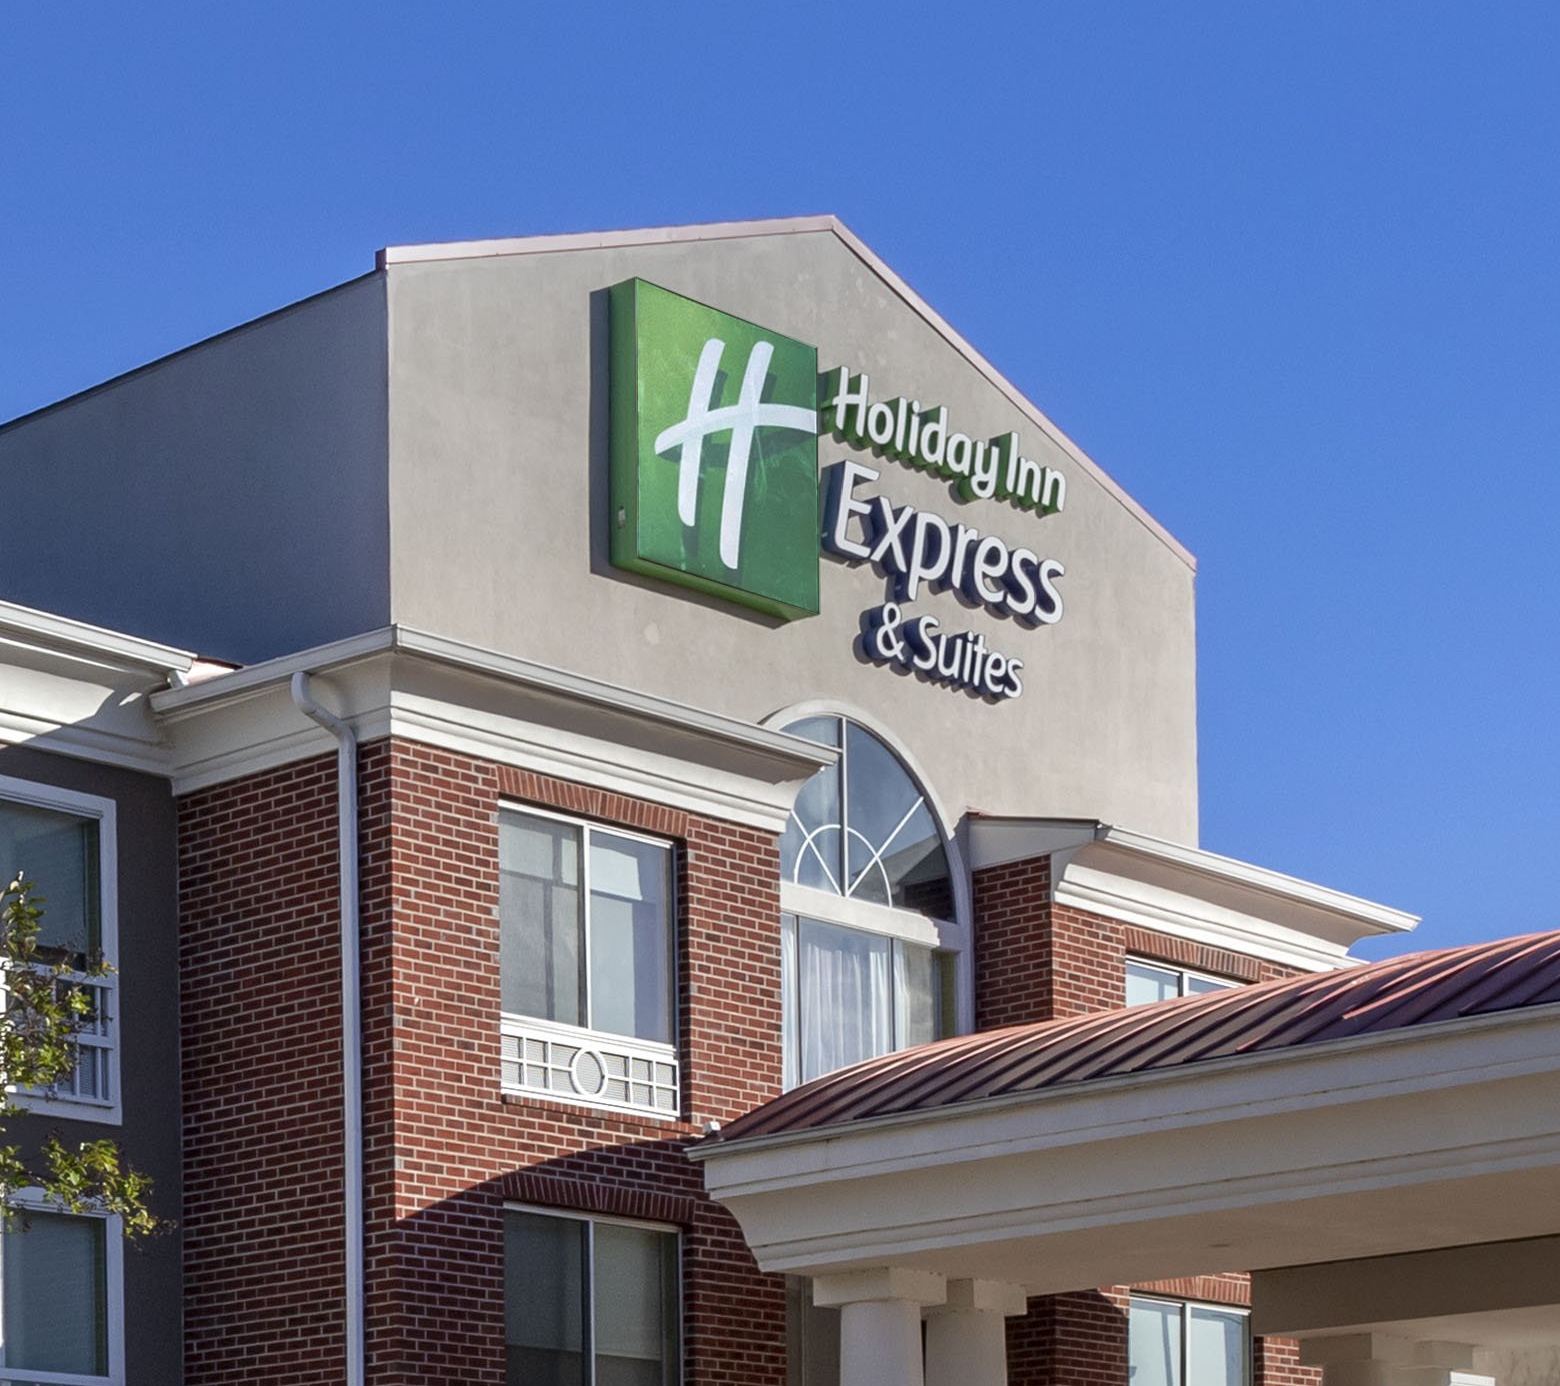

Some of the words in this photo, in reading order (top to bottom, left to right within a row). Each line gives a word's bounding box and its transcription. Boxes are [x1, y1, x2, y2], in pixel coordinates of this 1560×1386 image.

[832, 366, 1000, 499] Holiday
[1006, 431, 1067, 512] Inn
[834, 460, 1065, 625] Express
[876, 602, 905, 661] &
[913, 615, 1025, 699] Suites
